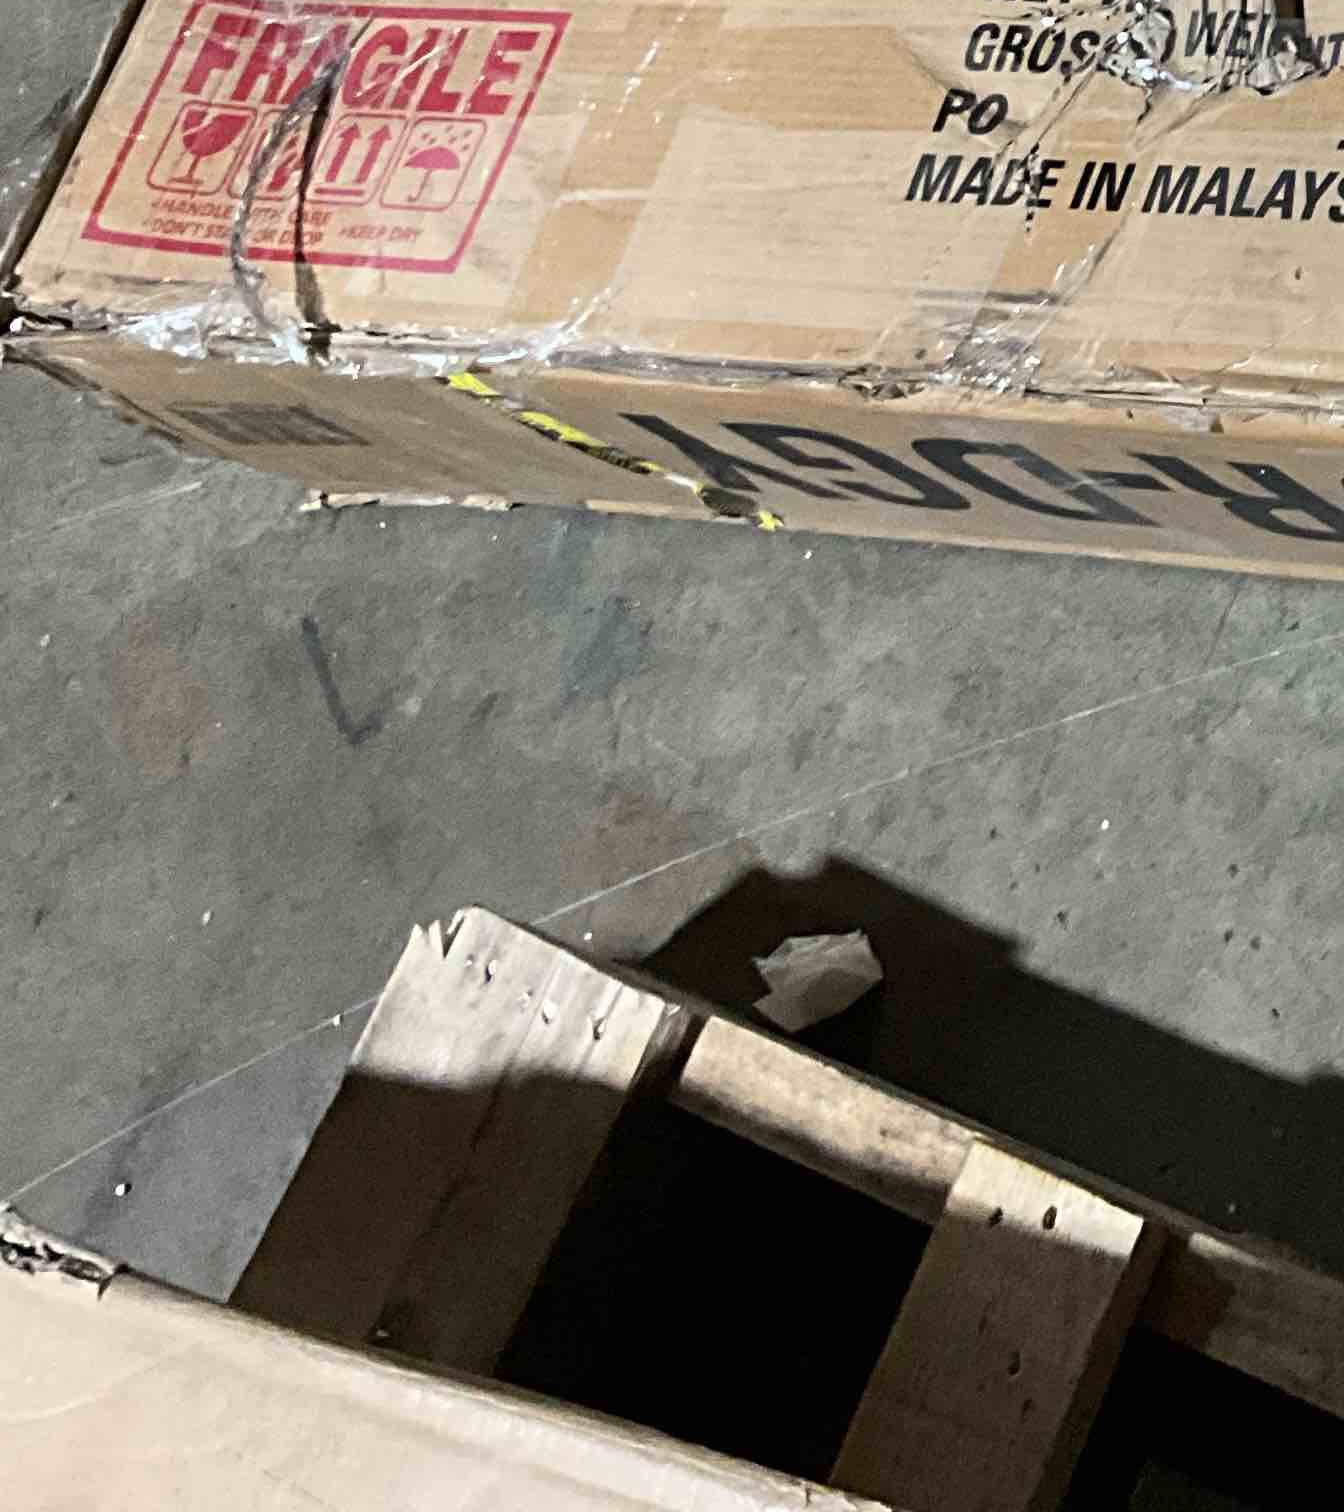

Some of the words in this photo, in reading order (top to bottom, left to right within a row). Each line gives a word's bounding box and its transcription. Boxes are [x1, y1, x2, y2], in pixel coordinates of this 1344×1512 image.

[182, 10, 540, 116] FRAGILE
[932, 87, 1009, 135] PO
[905, 153, 1066, 209] MADE
[1068, 160, 1136, 212] IN
